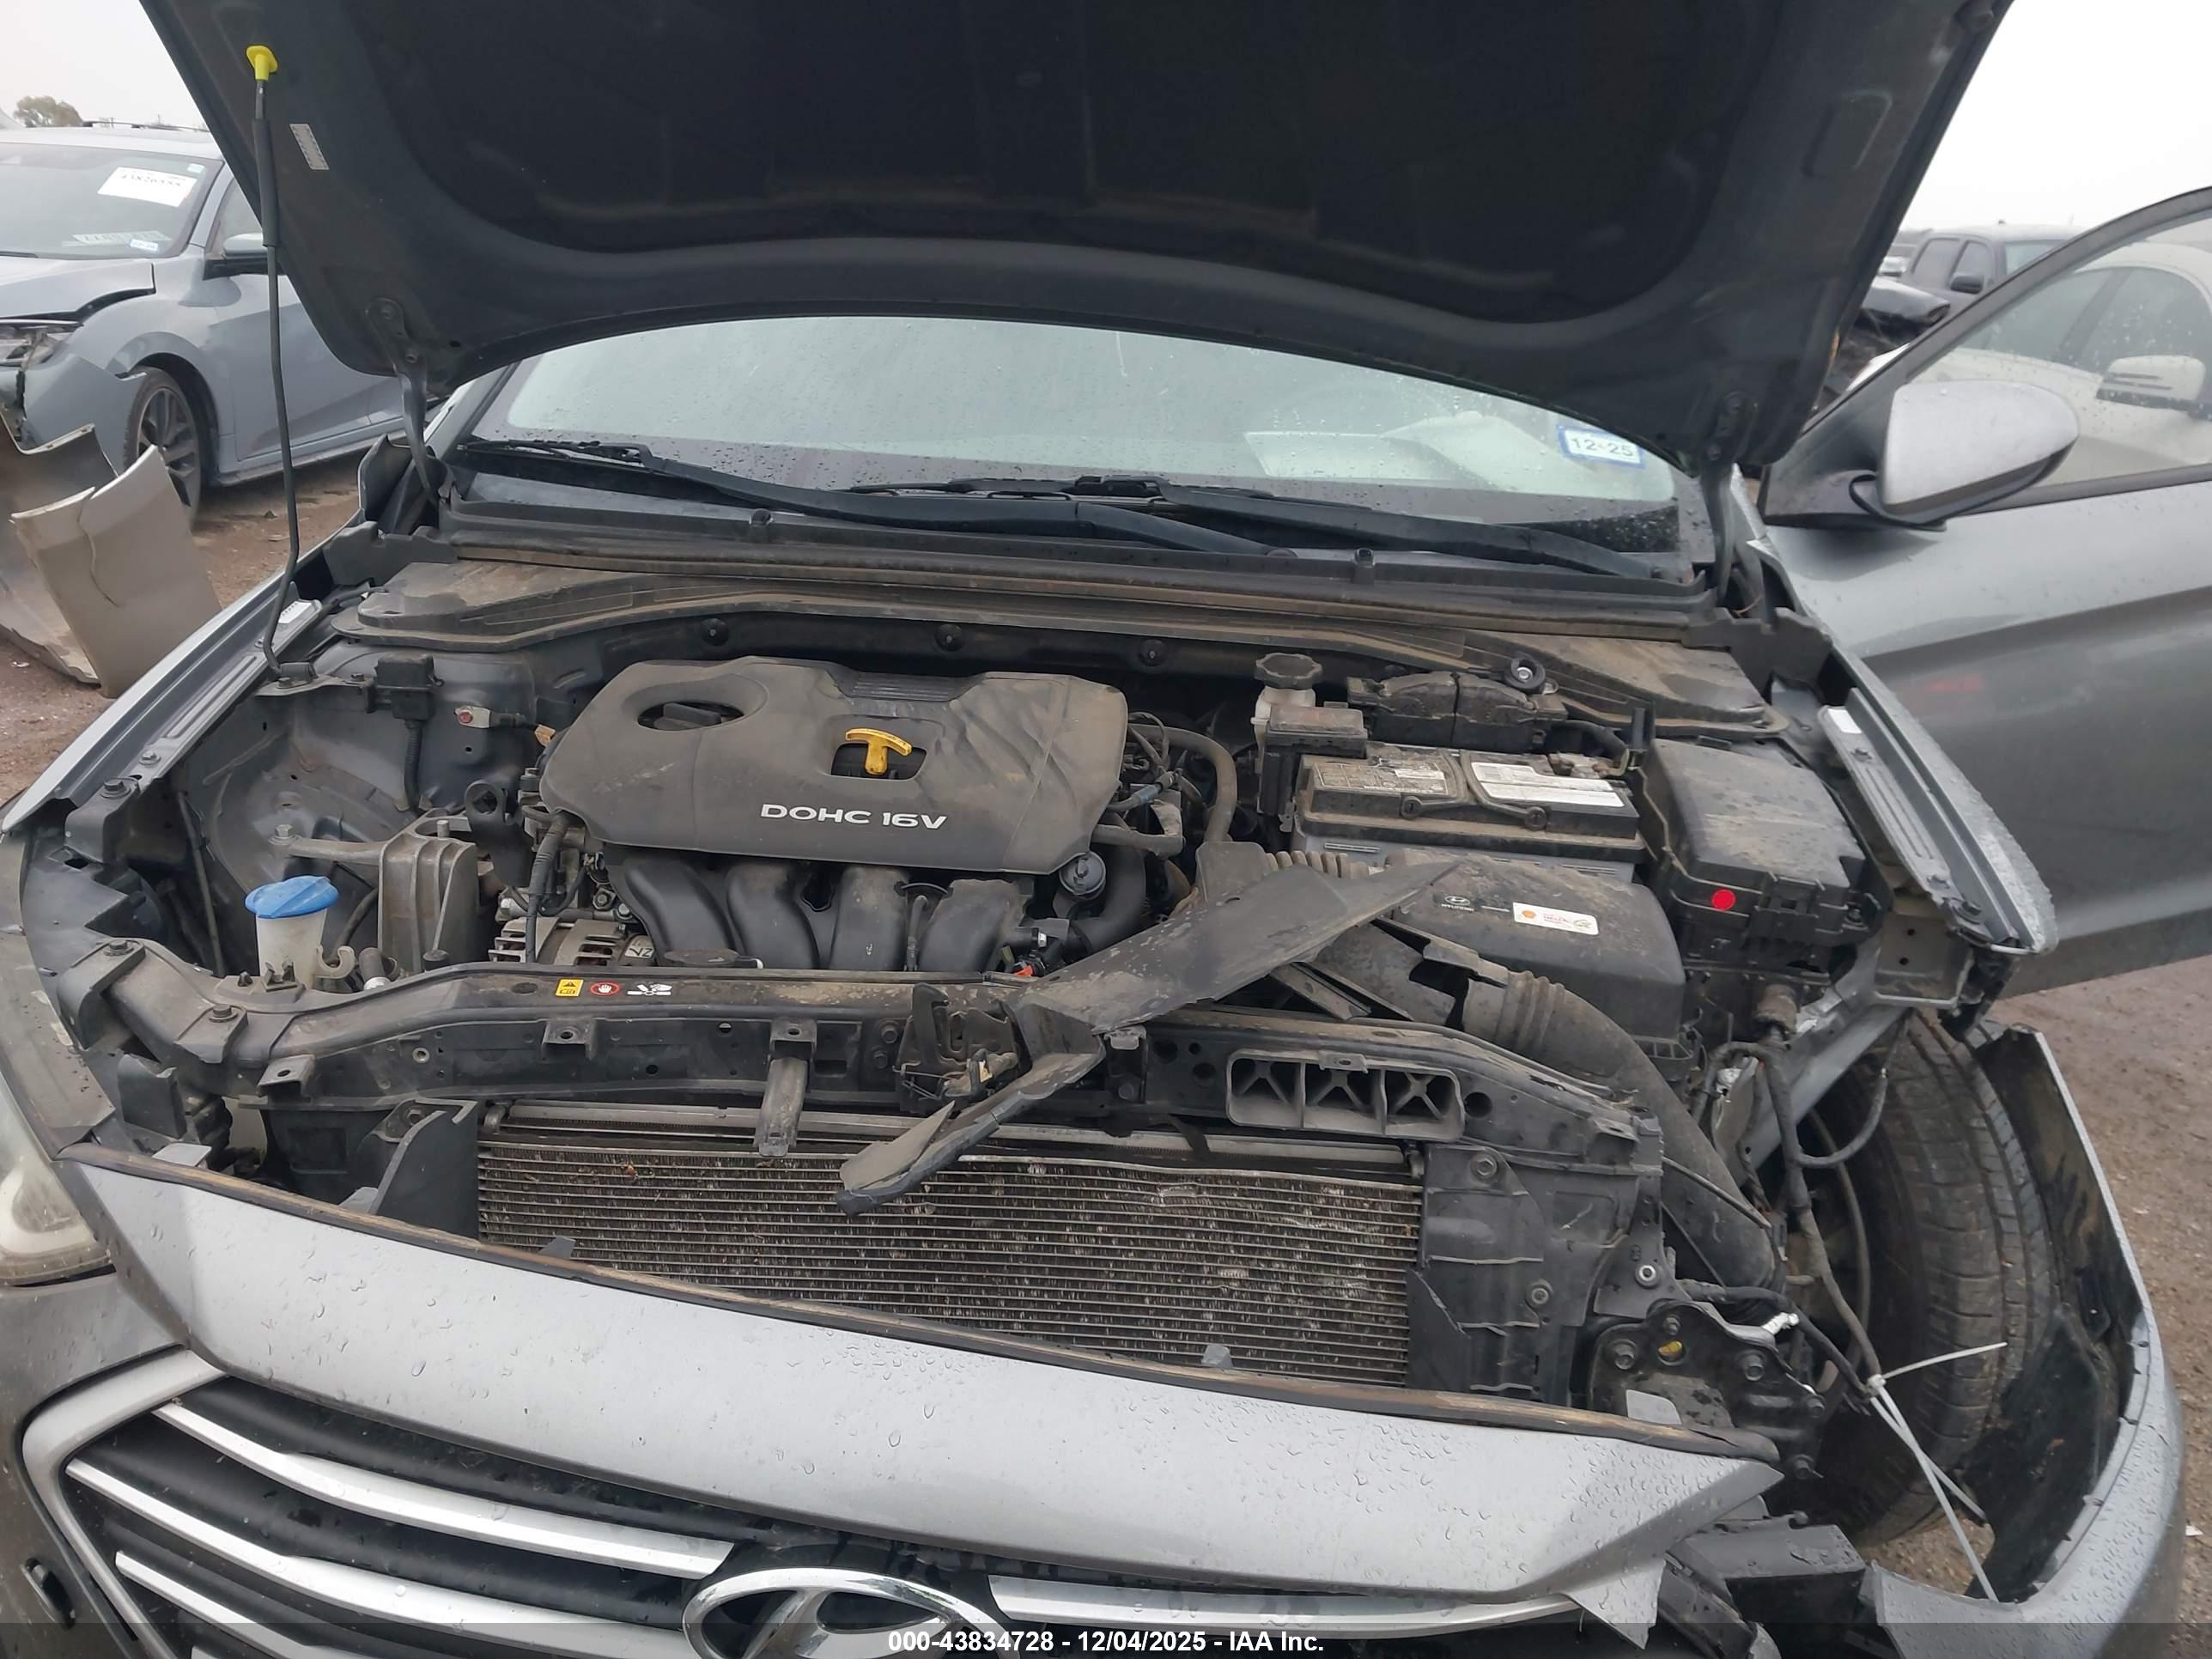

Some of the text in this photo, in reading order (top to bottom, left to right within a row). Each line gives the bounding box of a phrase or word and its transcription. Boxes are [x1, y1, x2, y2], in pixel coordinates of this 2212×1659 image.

[1571, 437, 1634, 457] 12-25
[760, 803, 948, 830] DOHC 16V
